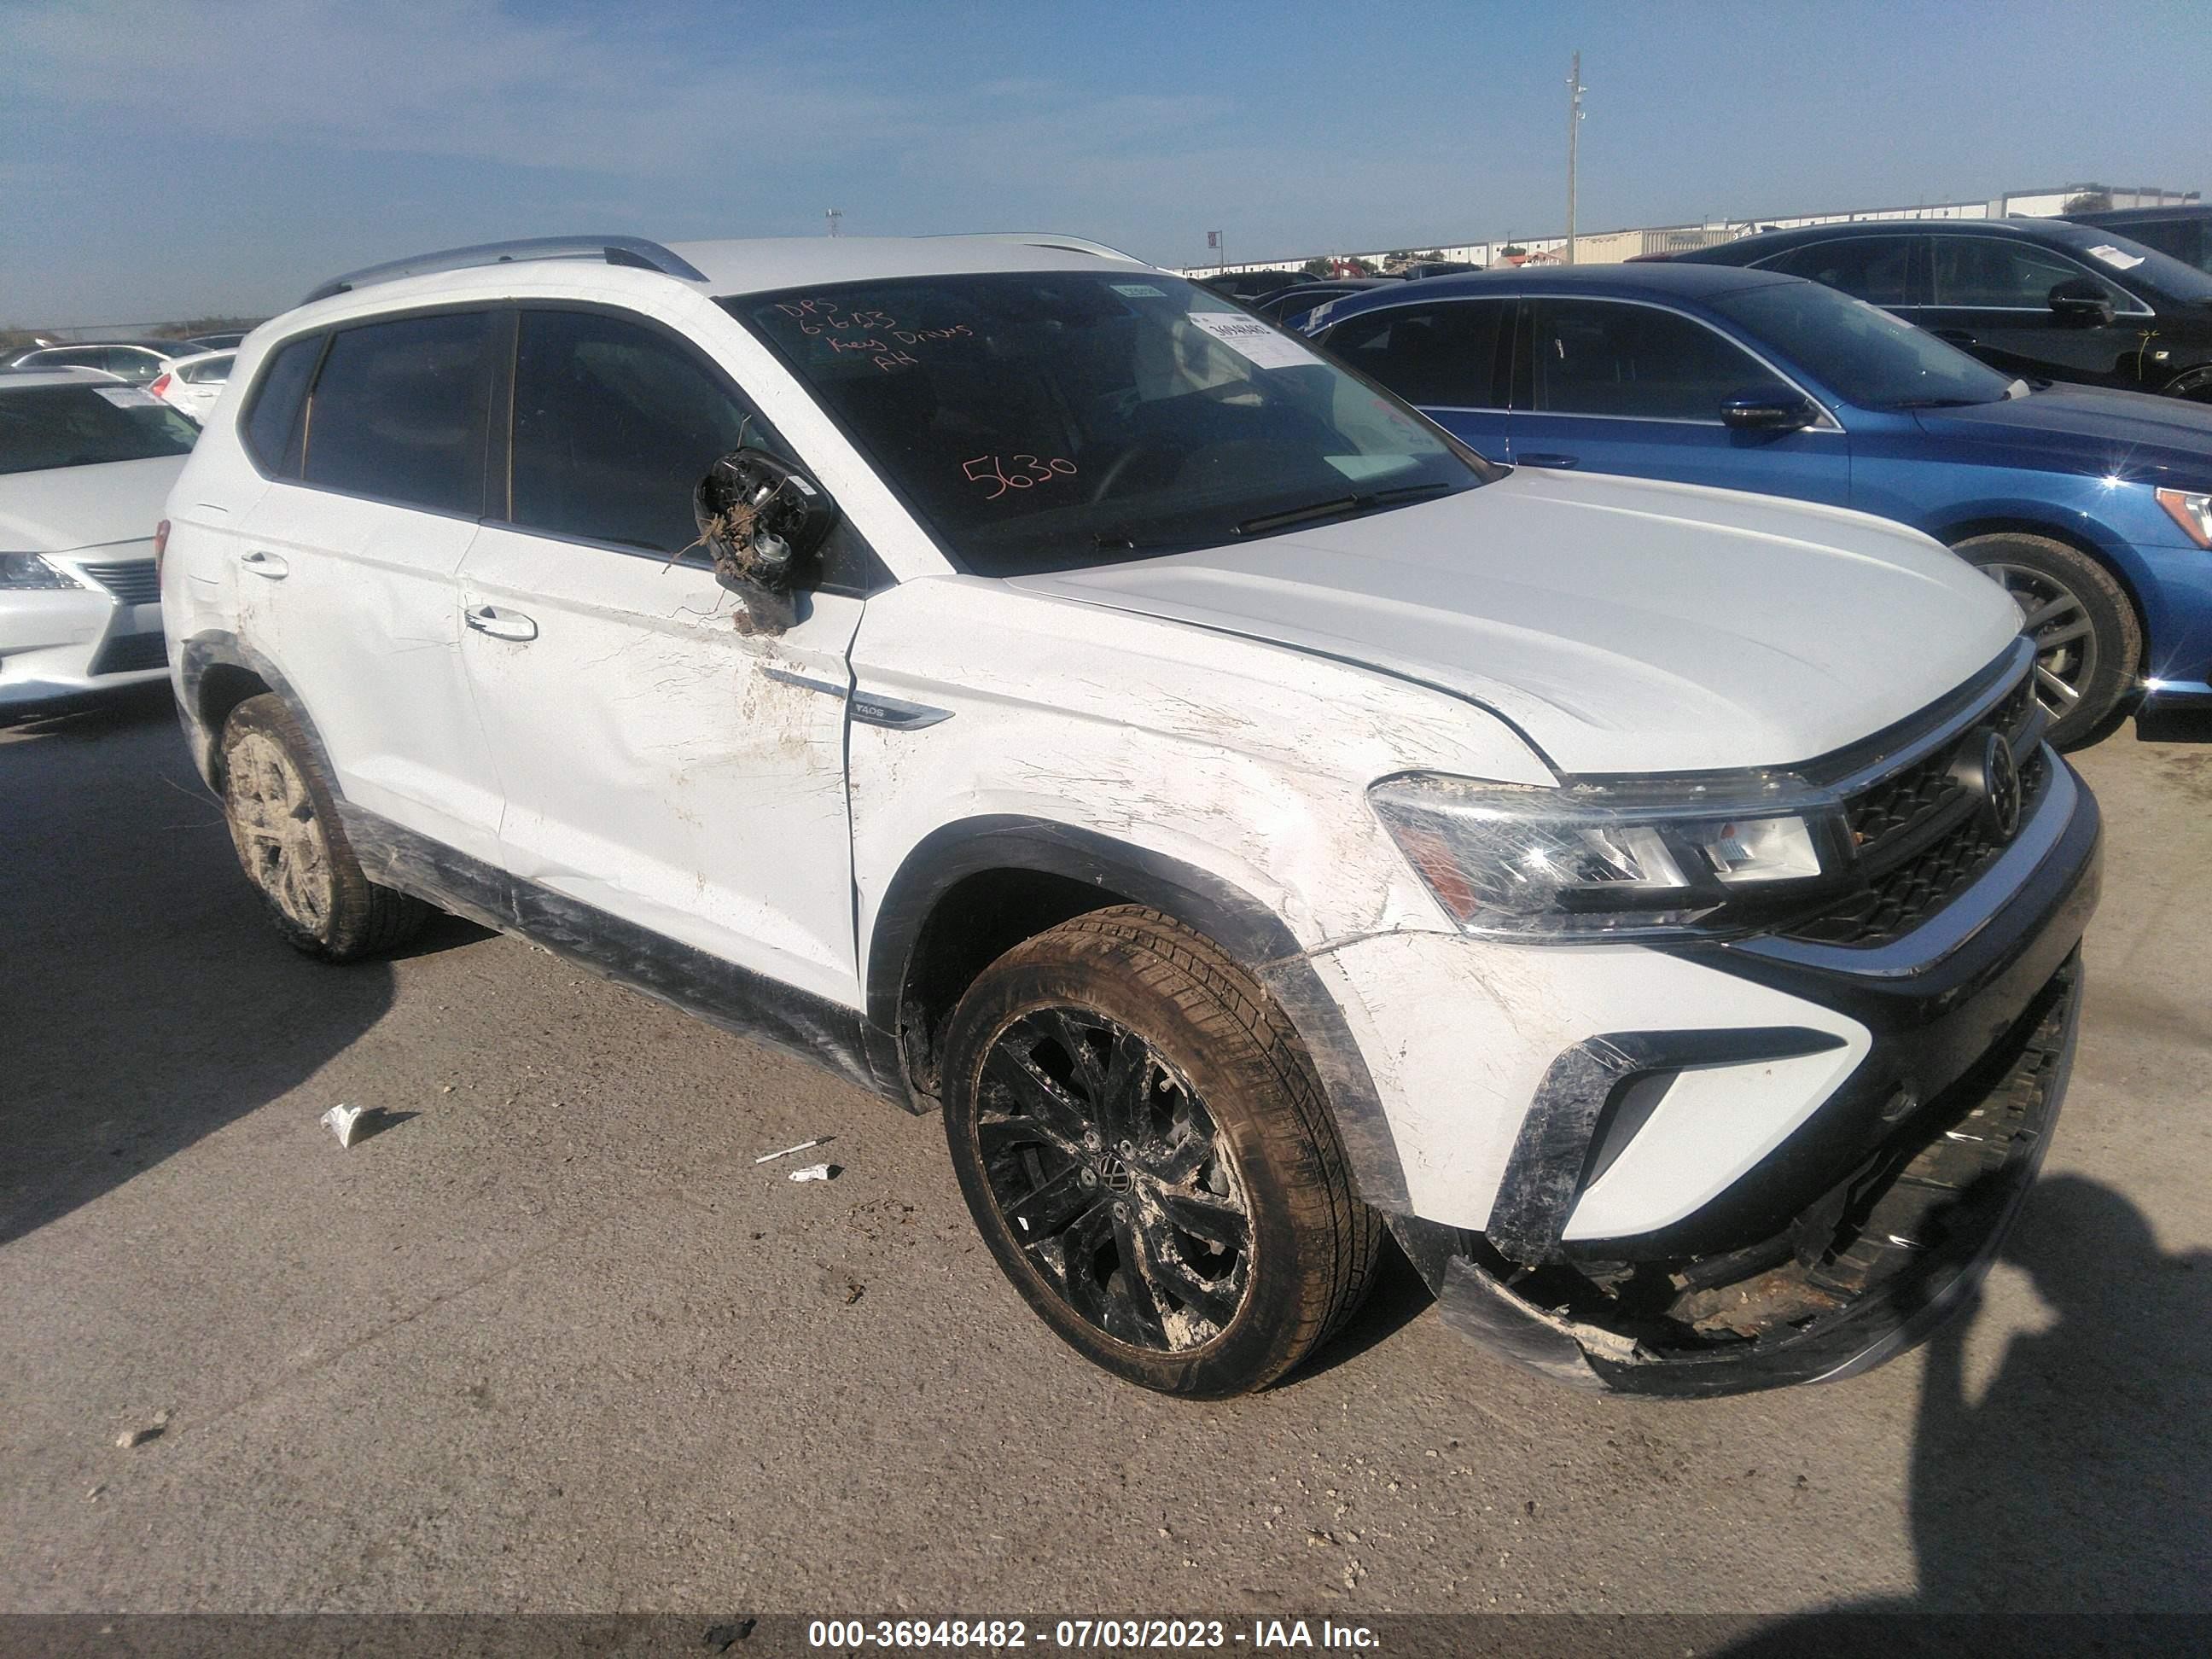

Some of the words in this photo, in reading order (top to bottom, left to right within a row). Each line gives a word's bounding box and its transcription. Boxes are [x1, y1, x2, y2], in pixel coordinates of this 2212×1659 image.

[775, 299, 838, 317] DPS
[963, 455, 1078, 499] 5630
[856, 704, 884, 717] TAOS
